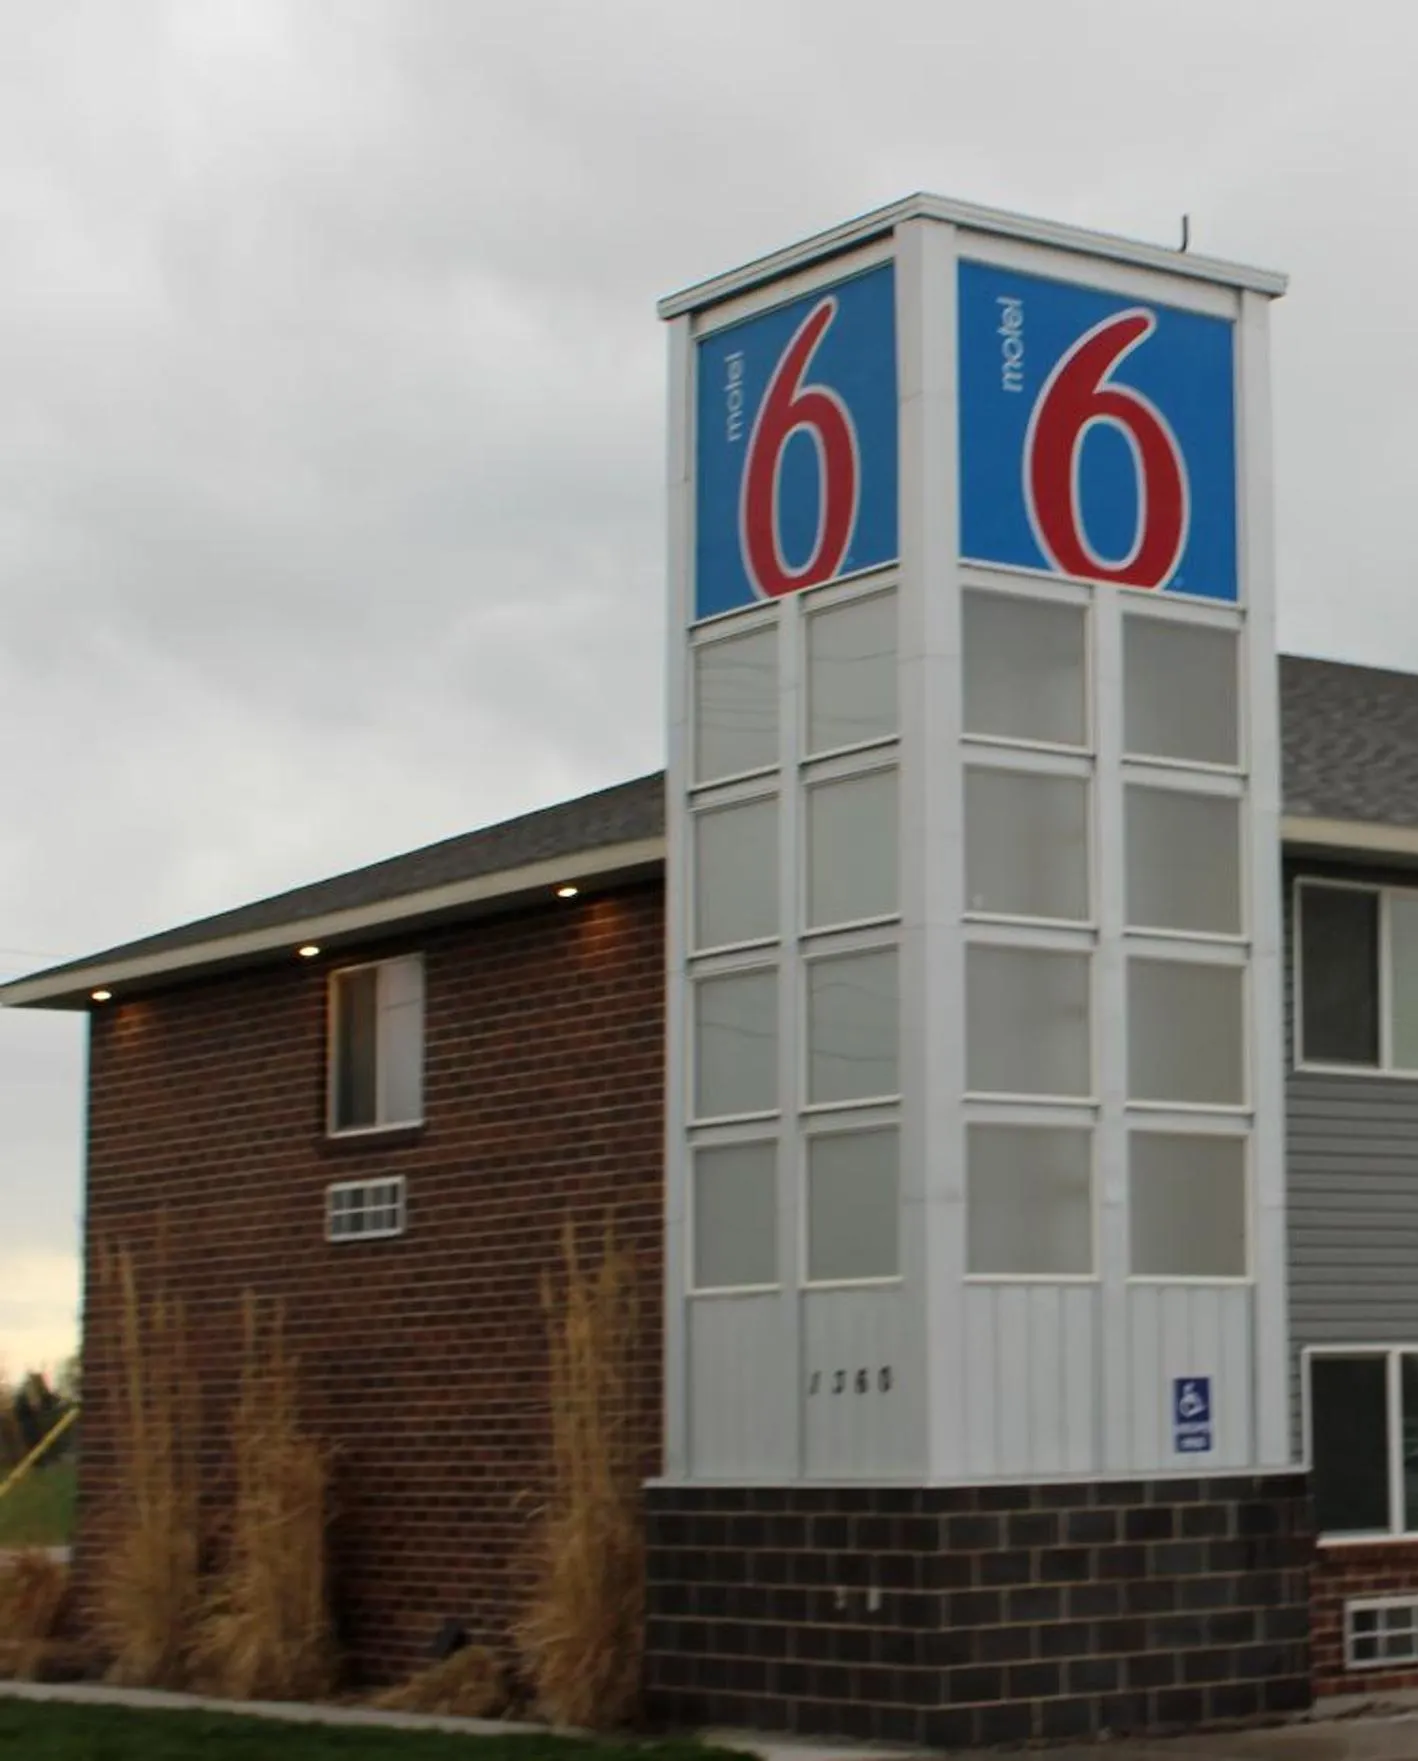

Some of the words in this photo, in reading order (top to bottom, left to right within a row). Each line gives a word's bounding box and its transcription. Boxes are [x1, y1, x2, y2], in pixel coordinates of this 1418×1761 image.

[724, 351, 744, 442] motel
[996, 296, 1023, 391] motel
[739, 295, 861, 599] 6
[1023, 306, 1191, 592] 6
